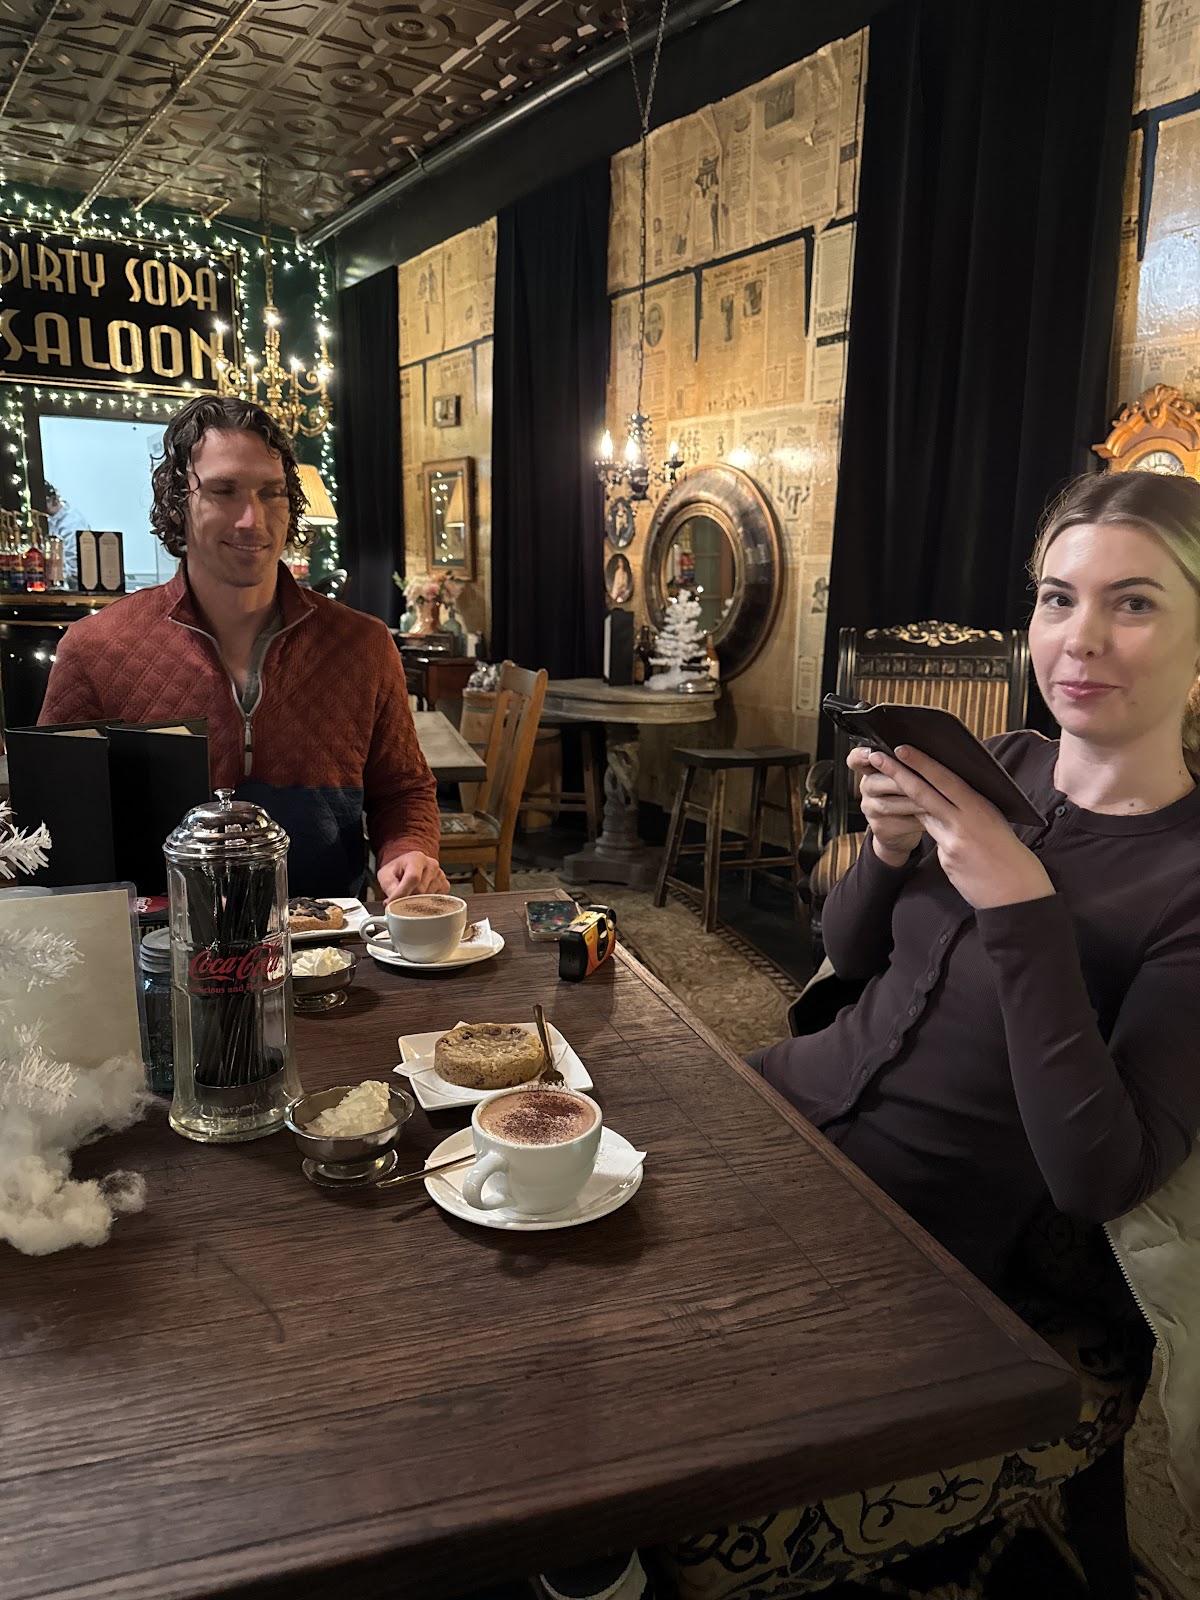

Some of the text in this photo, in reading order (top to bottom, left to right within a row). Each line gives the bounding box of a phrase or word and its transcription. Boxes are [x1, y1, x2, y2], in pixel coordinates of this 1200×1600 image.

[0, 241, 218, 312] DIRTY SODA
[0, 308, 219, 381] SALOON
[189, 940, 282, 981] Coca-Cola
[228, 985, 244, 993] and
